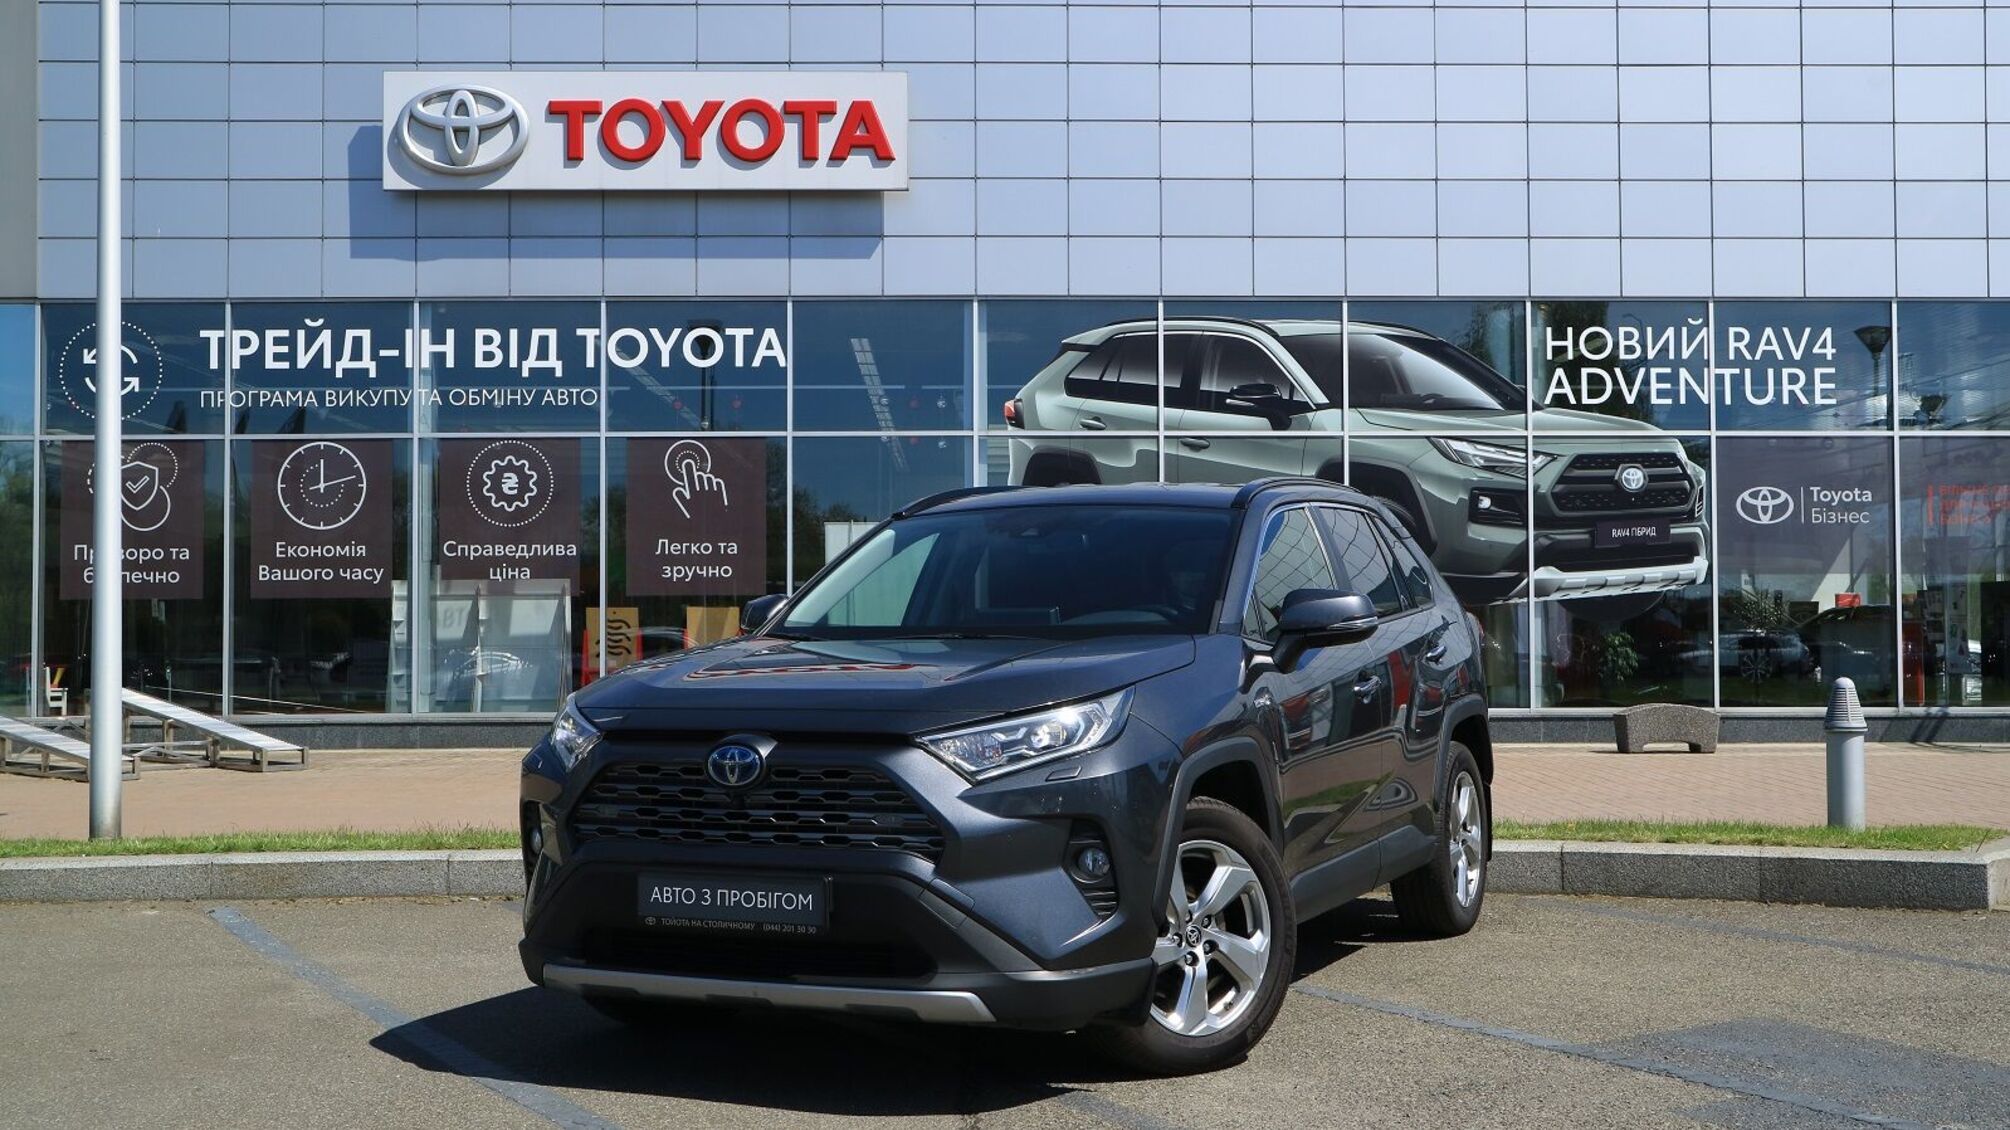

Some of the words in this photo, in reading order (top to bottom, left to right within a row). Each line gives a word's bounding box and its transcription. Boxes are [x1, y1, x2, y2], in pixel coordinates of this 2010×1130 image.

[548, 98, 896, 163] TOYOTA
[199, 318, 455, 378] ТРЕЙД-ІН
[474, 328, 563, 377] ВІД
[576, 327, 787, 368] TOYOTA
[1545, 317, 1709, 361] НОВИЙ
[1728, 326, 1837, 361] RAV4
[1544, 367, 1837, 406] ADVENTURE
[200, 389, 318, 408] ПРОГРАМА
[325, 388, 412, 408] ВИКУПУ
[418, 388, 443, 406] ТА
[449, 387, 534, 407] ОБМІНУ
[541, 387, 598, 407] АВТО
[1810, 486, 1872, 506] Toyota
[1811, 508, 1870, 524] Бізнес
[1611, 528, 1630, 538] RAV4
[74, 544, 164, 564] Поро
[170, 547, 190, 560] та
[275, 541, 366, 558] Економія
[443, 541, 577, 560] Справедлива
[655, 538, 713, 555] Легко
[718, 542, 738, 555] та
[83, 566, 180, 584] бпечно
[258, 565, 332, 581] Вашого
[340, 567, 384, 583] часу
[489, 564, 531, 580] ціна
[661, 565, 733, 582] зручно
[650, 886, 697, 905] АВТО
[700, 888, 712, 906] З
[717, 889, 813, 911] ПРОБІГОМ
